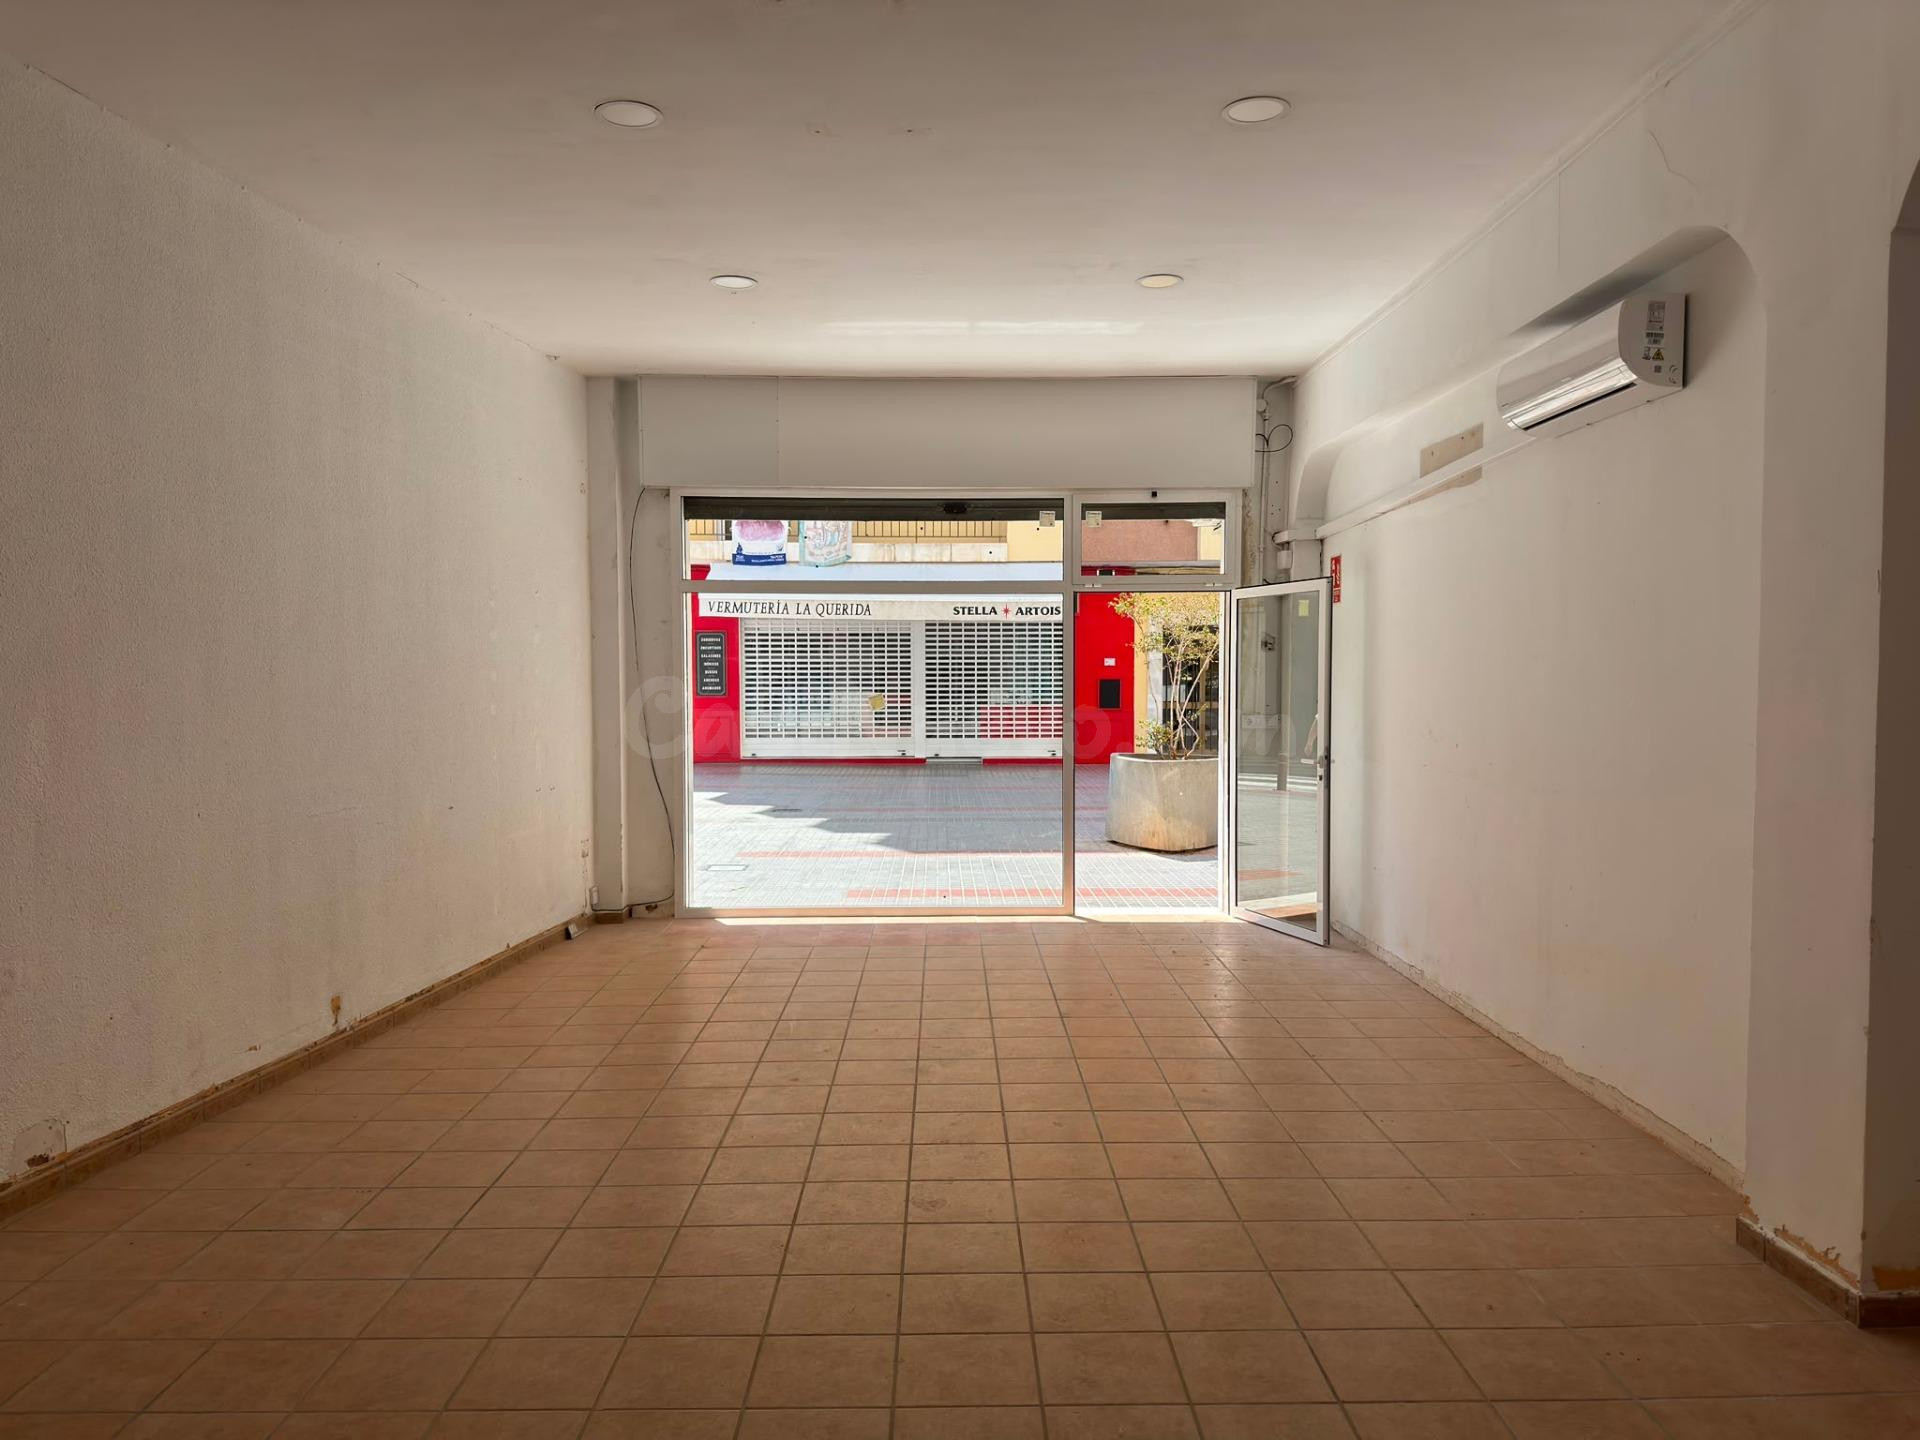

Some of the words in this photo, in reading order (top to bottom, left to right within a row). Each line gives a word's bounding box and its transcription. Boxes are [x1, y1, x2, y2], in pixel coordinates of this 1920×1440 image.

[708, 600, 790, 615] VERMUTERÍA
[796, 602, 811, 616] LA
[816, 603, 872, 618] QUERIDA
[953, 606, 998, 616] STELLA
[1015, 606, 1062, 616] ARTOIS
